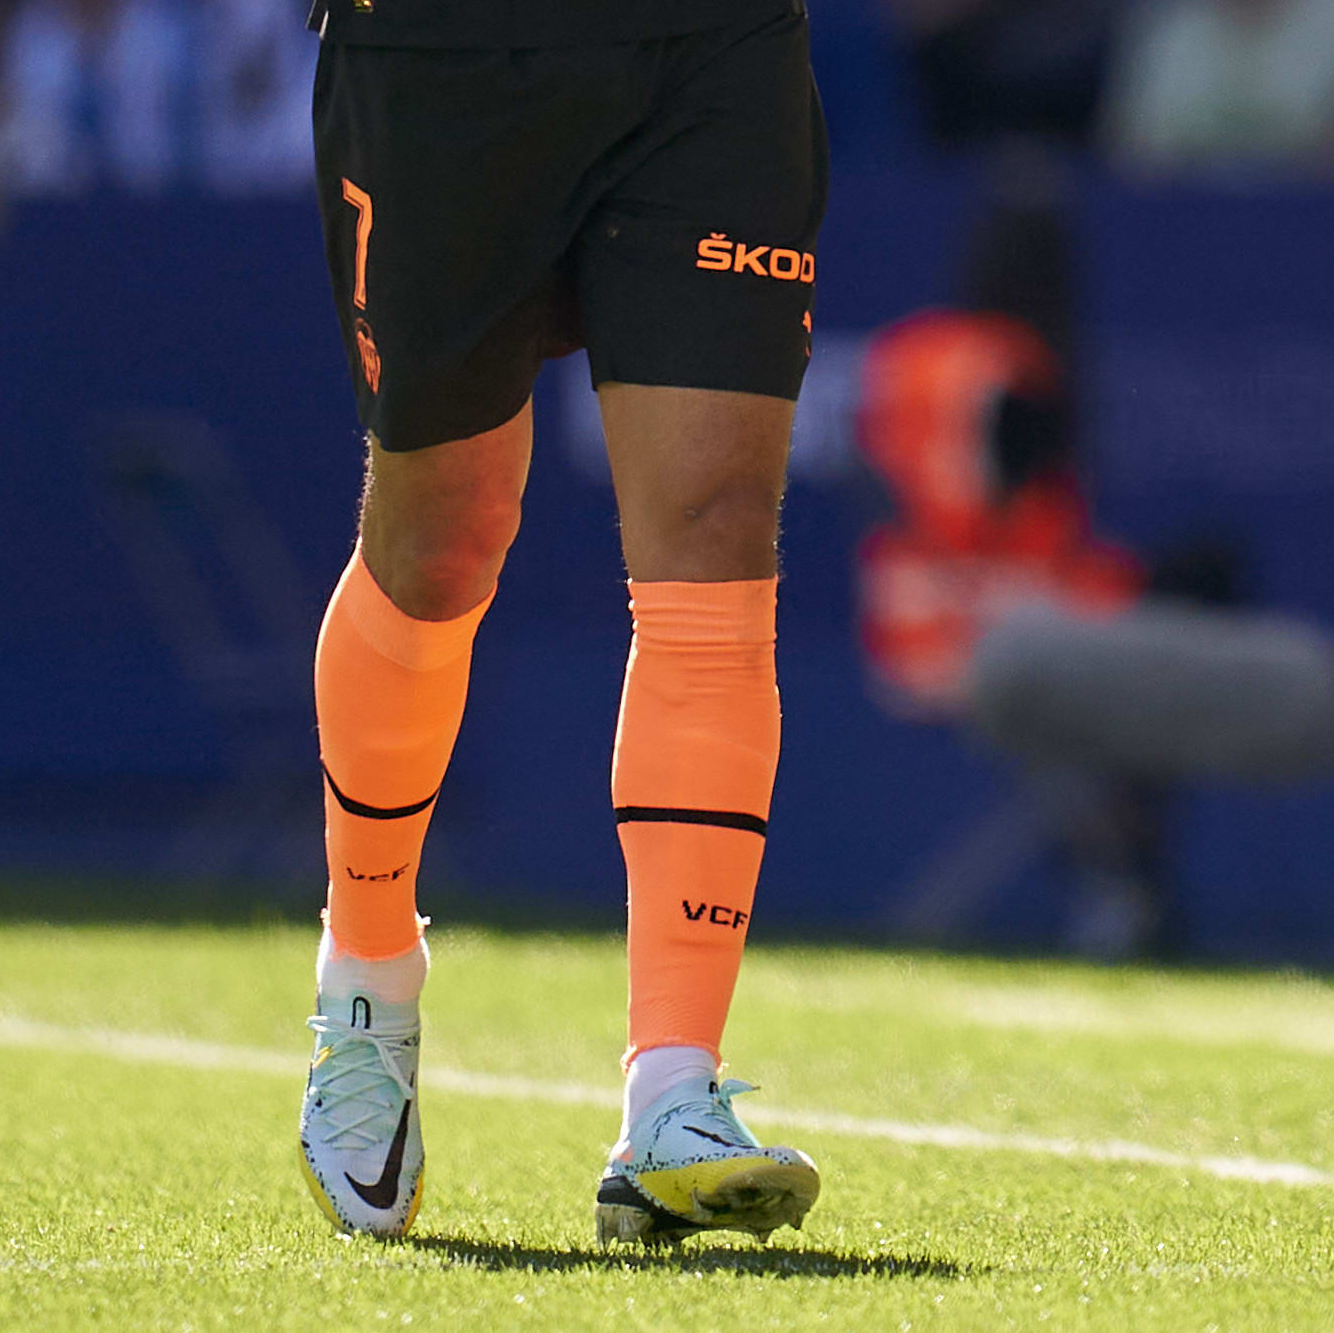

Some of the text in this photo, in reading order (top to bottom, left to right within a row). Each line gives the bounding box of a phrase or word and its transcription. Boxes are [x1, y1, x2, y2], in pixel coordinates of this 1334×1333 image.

[341, 177, 373, 311] 7
[696, 232, 815, 284] ŠKOD
[682, 900, 748, 929] VCF
